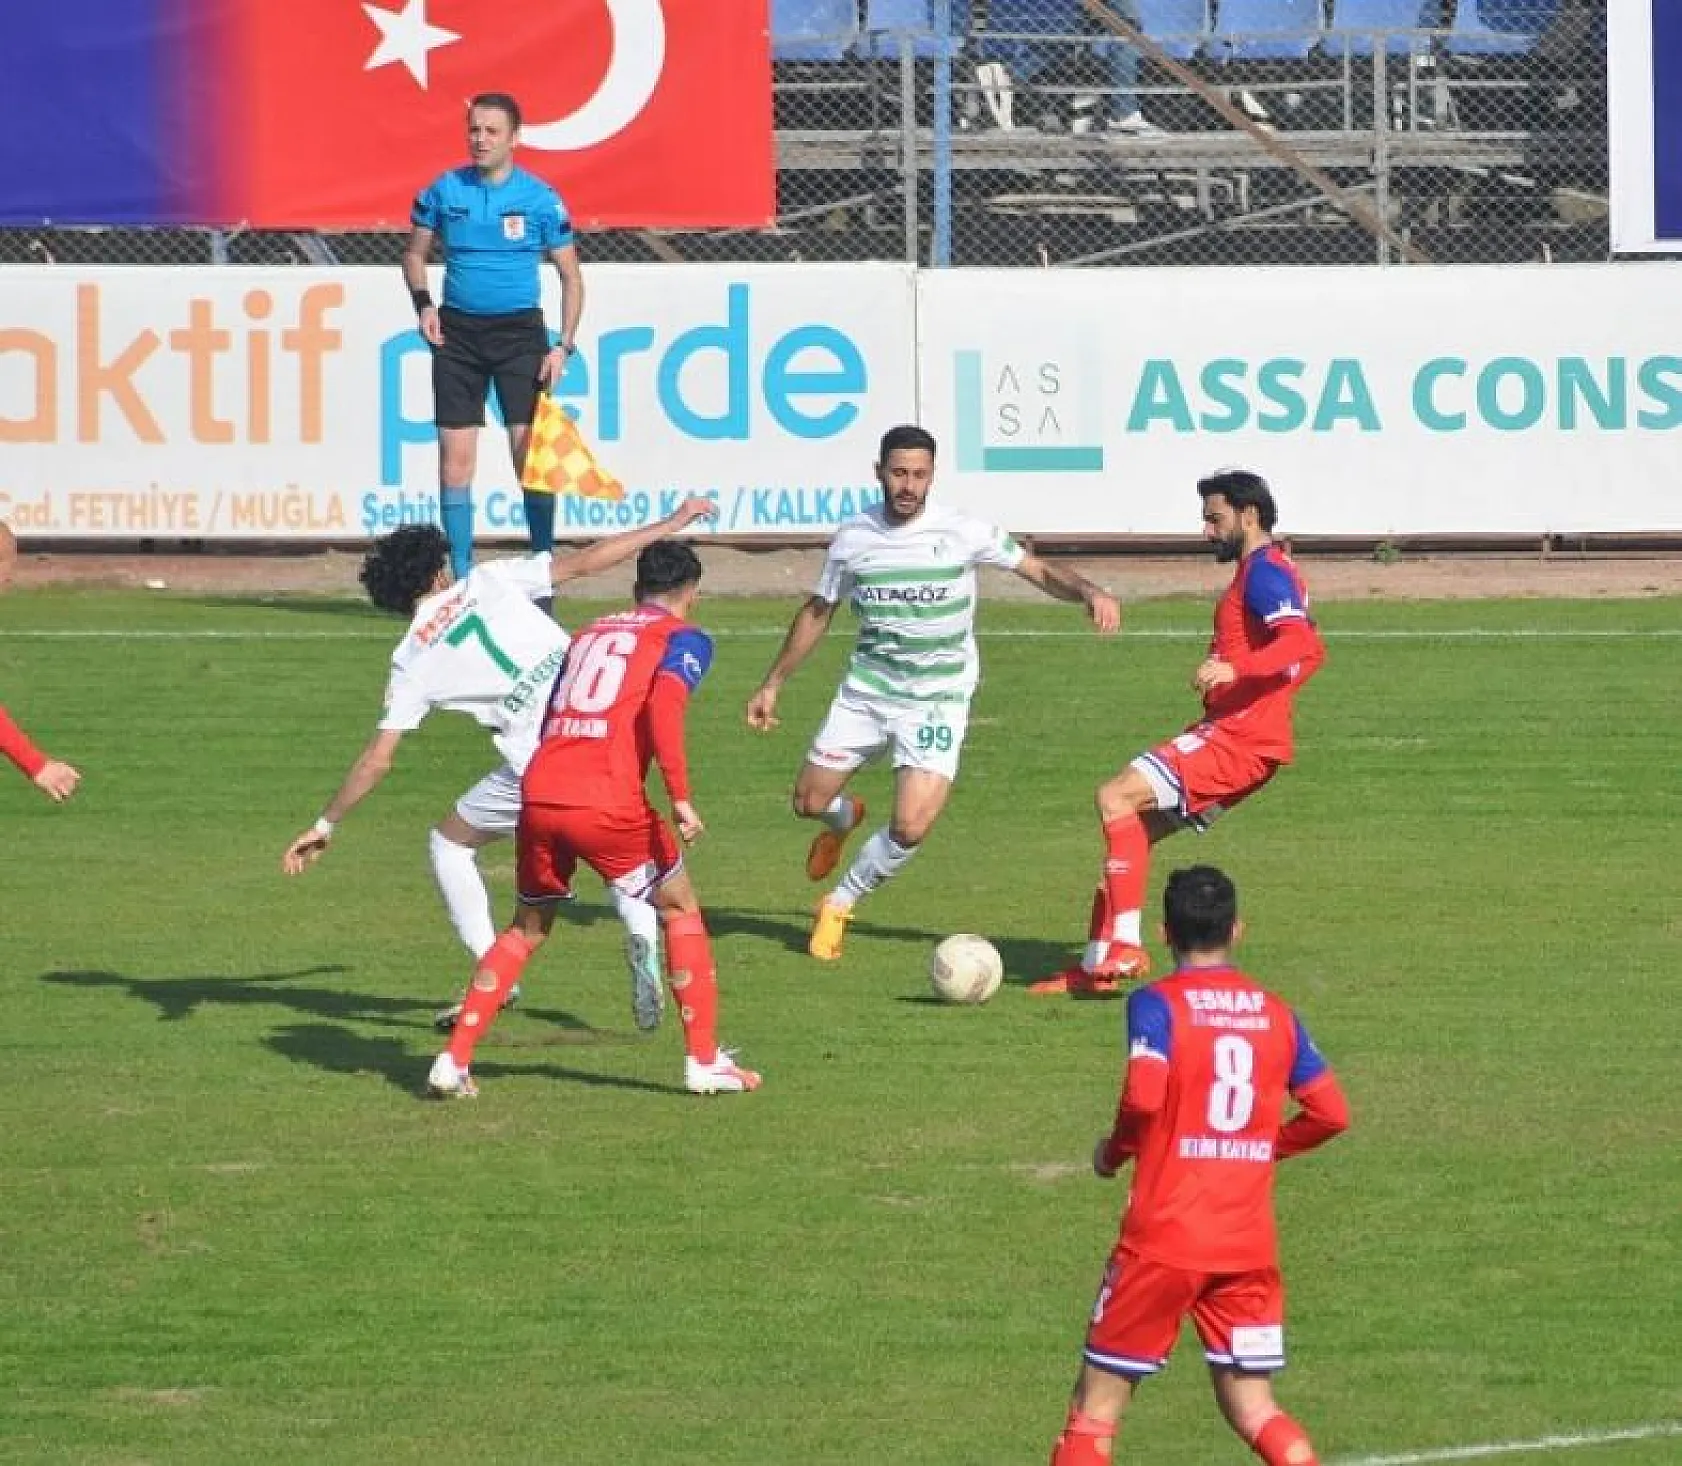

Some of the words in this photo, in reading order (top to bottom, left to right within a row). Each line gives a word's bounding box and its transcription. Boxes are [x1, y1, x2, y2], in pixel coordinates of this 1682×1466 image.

[0, 283, 346, 444] aktif
[1125, 357, 1382, 432] ASSA
[1411, 356, 1682, 432] CONS
[0, 488, 61, 529] ad.
[68, 483, 198, 529] FETHİYE
[231, 483, 346, 529] MUĞLA
[485, 491, 526, 526] Ca
[659, 488, 720, 533] KŞ
[444, 611, 523, 680] 7
[549, 631, 638, 714] 16
[917, 725, 954, 751] 99
[1206, 1035, 1255, 1133] 8
